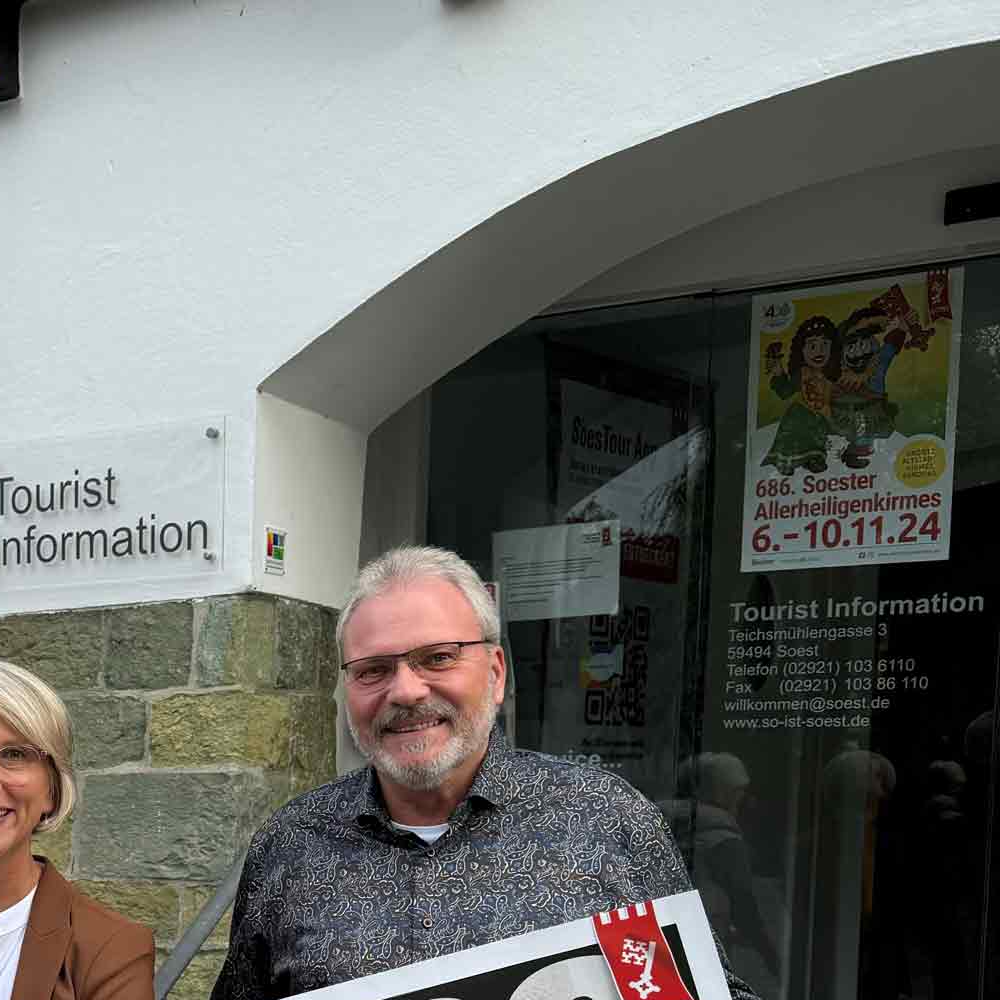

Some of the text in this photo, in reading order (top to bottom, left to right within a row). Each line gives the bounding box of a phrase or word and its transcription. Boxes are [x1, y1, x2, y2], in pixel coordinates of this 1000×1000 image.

[755, 472, 877, 497] 686. Soester
[754, 491, 941, 521] Allerheiligenkirmes
[730, 592, 984, 622] Tourist Information
[727, 624, 888, 642] Teichsmühlengasse 3
[727, 645, 819, 659] 59494 Soest
[727, 658, 915, 677] Telefon (02921) 103 6110
[726, 676, 928, 694] Fax (02921) 103 86 110
[724, 696, 890, 713] willkommen@soest.de
[724, 715, 870, 729] www.so-ist-soest.de
